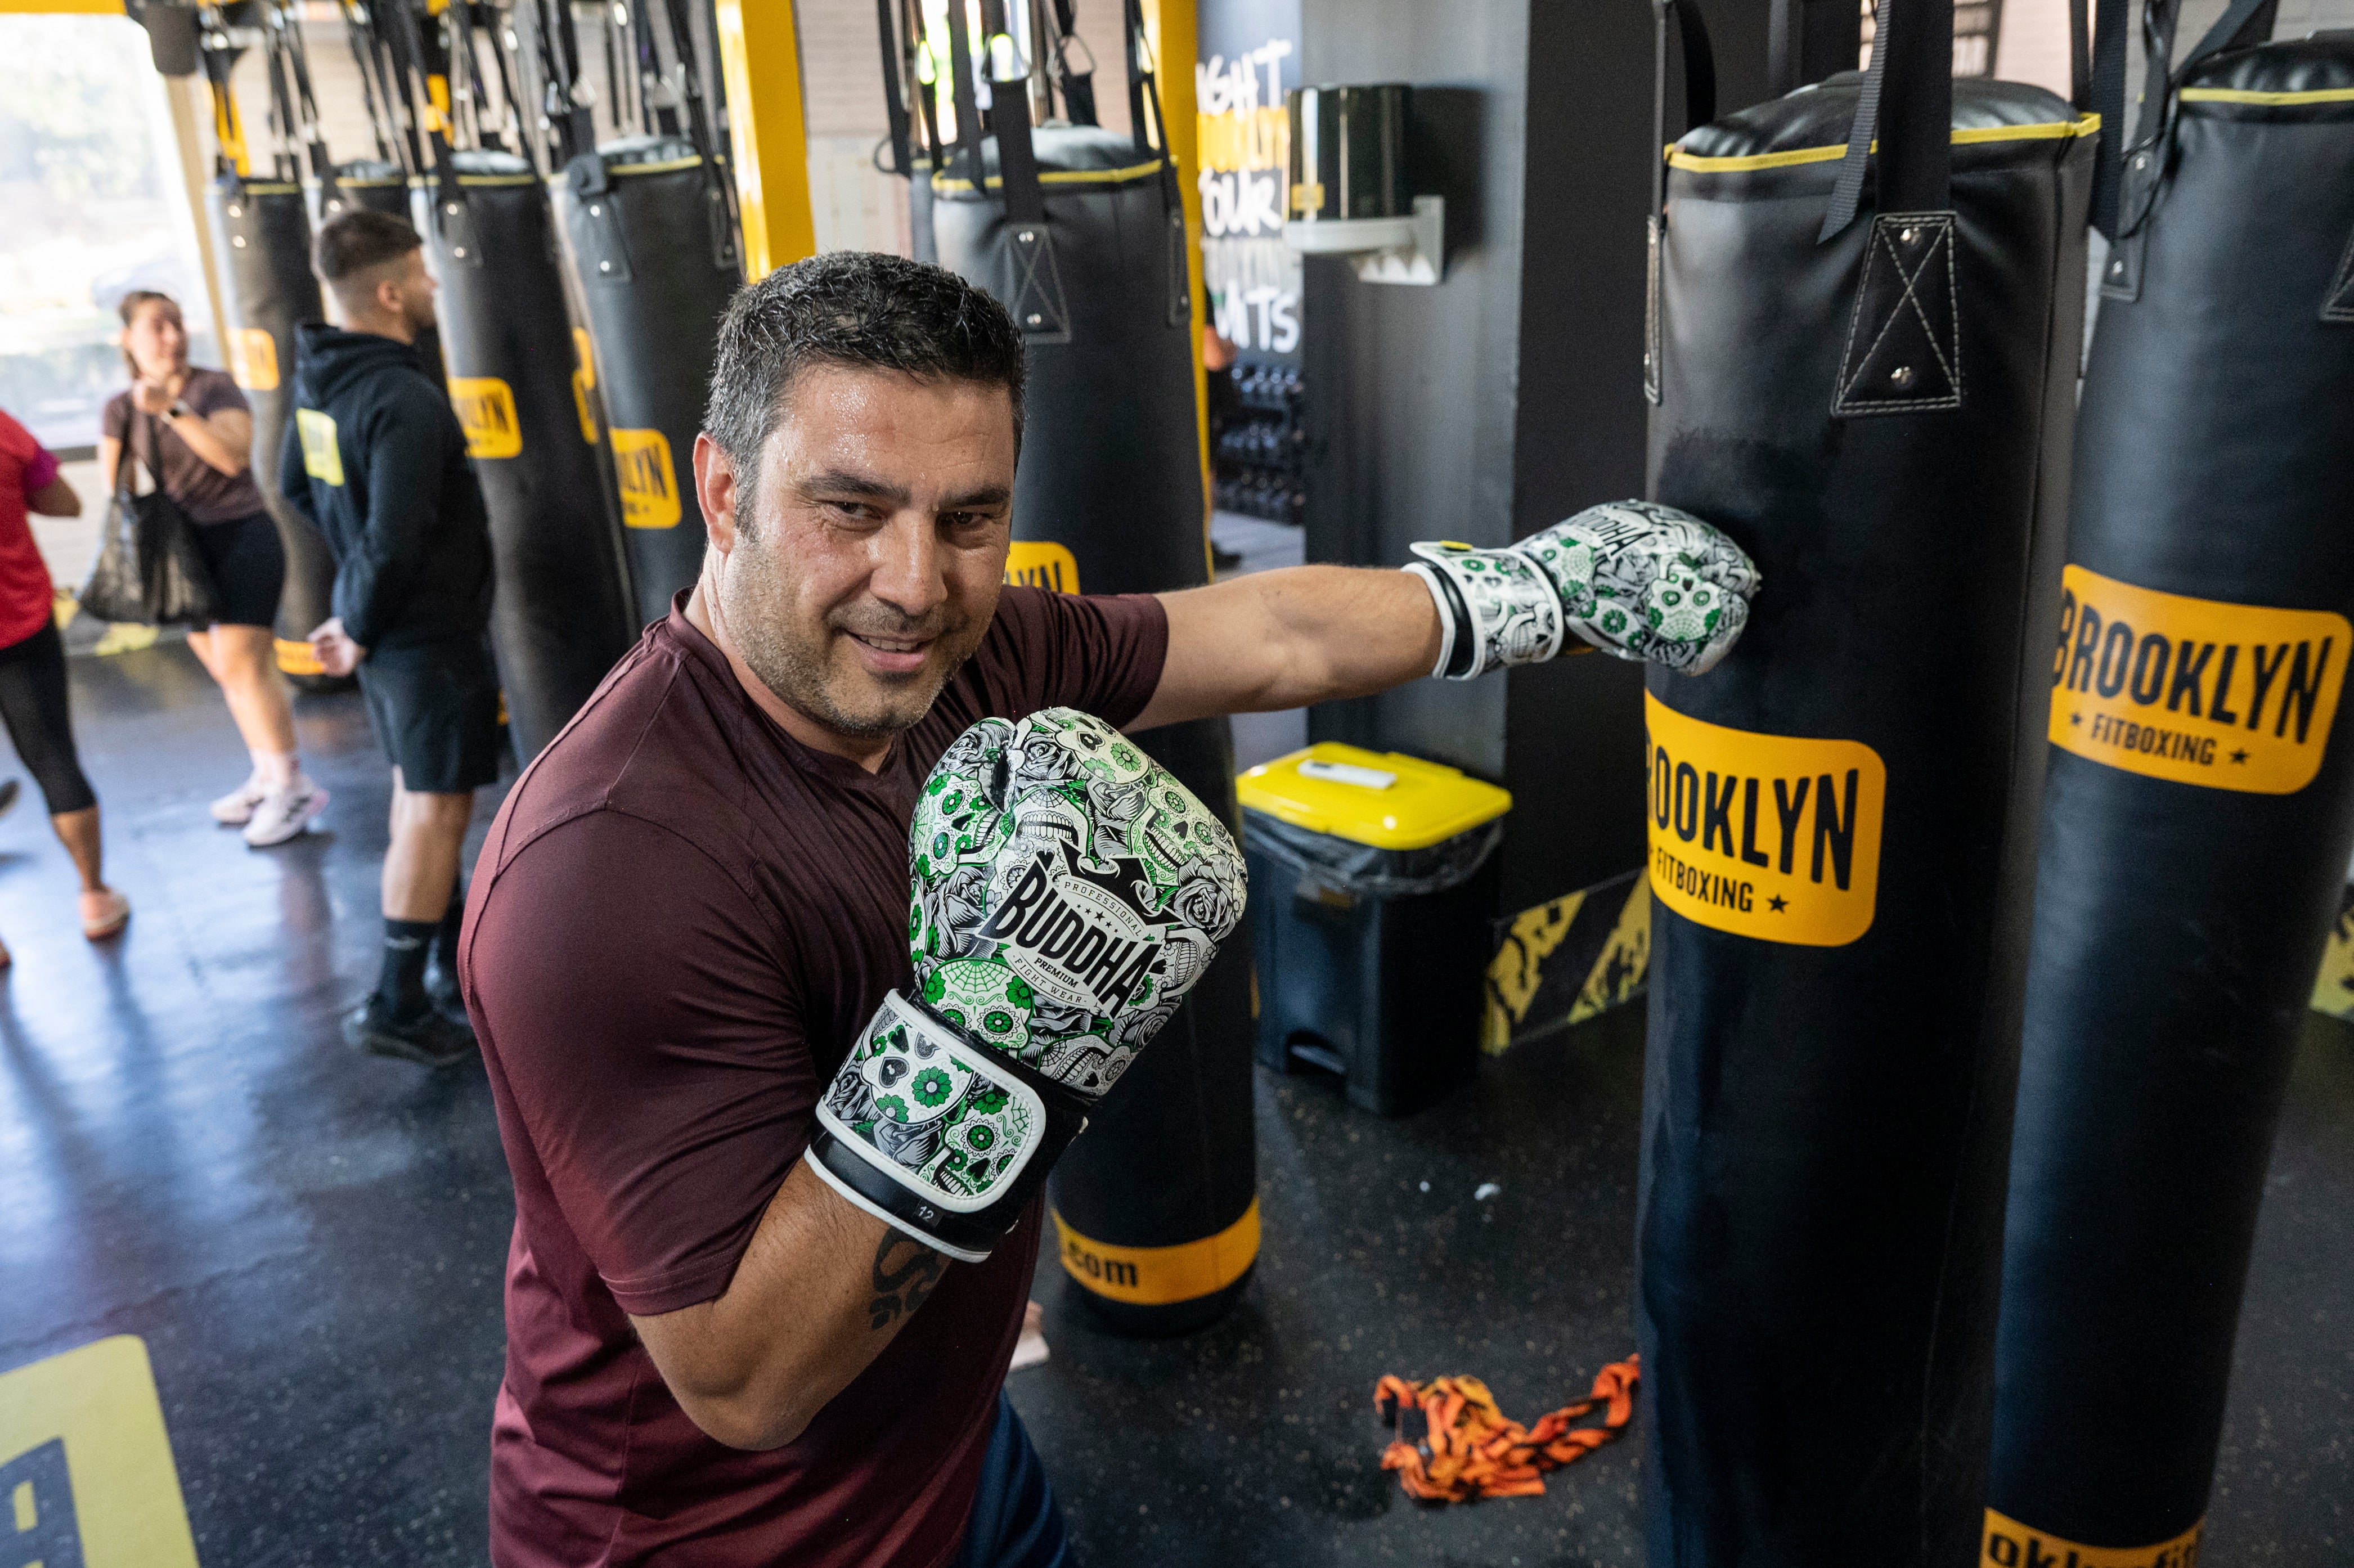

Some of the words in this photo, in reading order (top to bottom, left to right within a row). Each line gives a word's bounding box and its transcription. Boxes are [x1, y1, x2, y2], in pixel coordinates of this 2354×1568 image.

[1195, 38, 1292, 121] IGHT
[2052, 586, 2333, 744] BROOKLYN
[2091, 713, 2217, 766] FITBOXING
[1656, 847, 1754, 913] FITBOXING
[1064, 881, 1140, 937] PROFESSIONAL
[977, 860, 1163, 1019] BUDDHA
[1014, 958, 1045, 992] FIGHT
[1050, 986, 1082, 1004] WEAR
[1034, 958, 1079, 988] PREMIUM
[918, 1206, 934, 1221] 12
[1067, 1242, 1137, 1287] com
